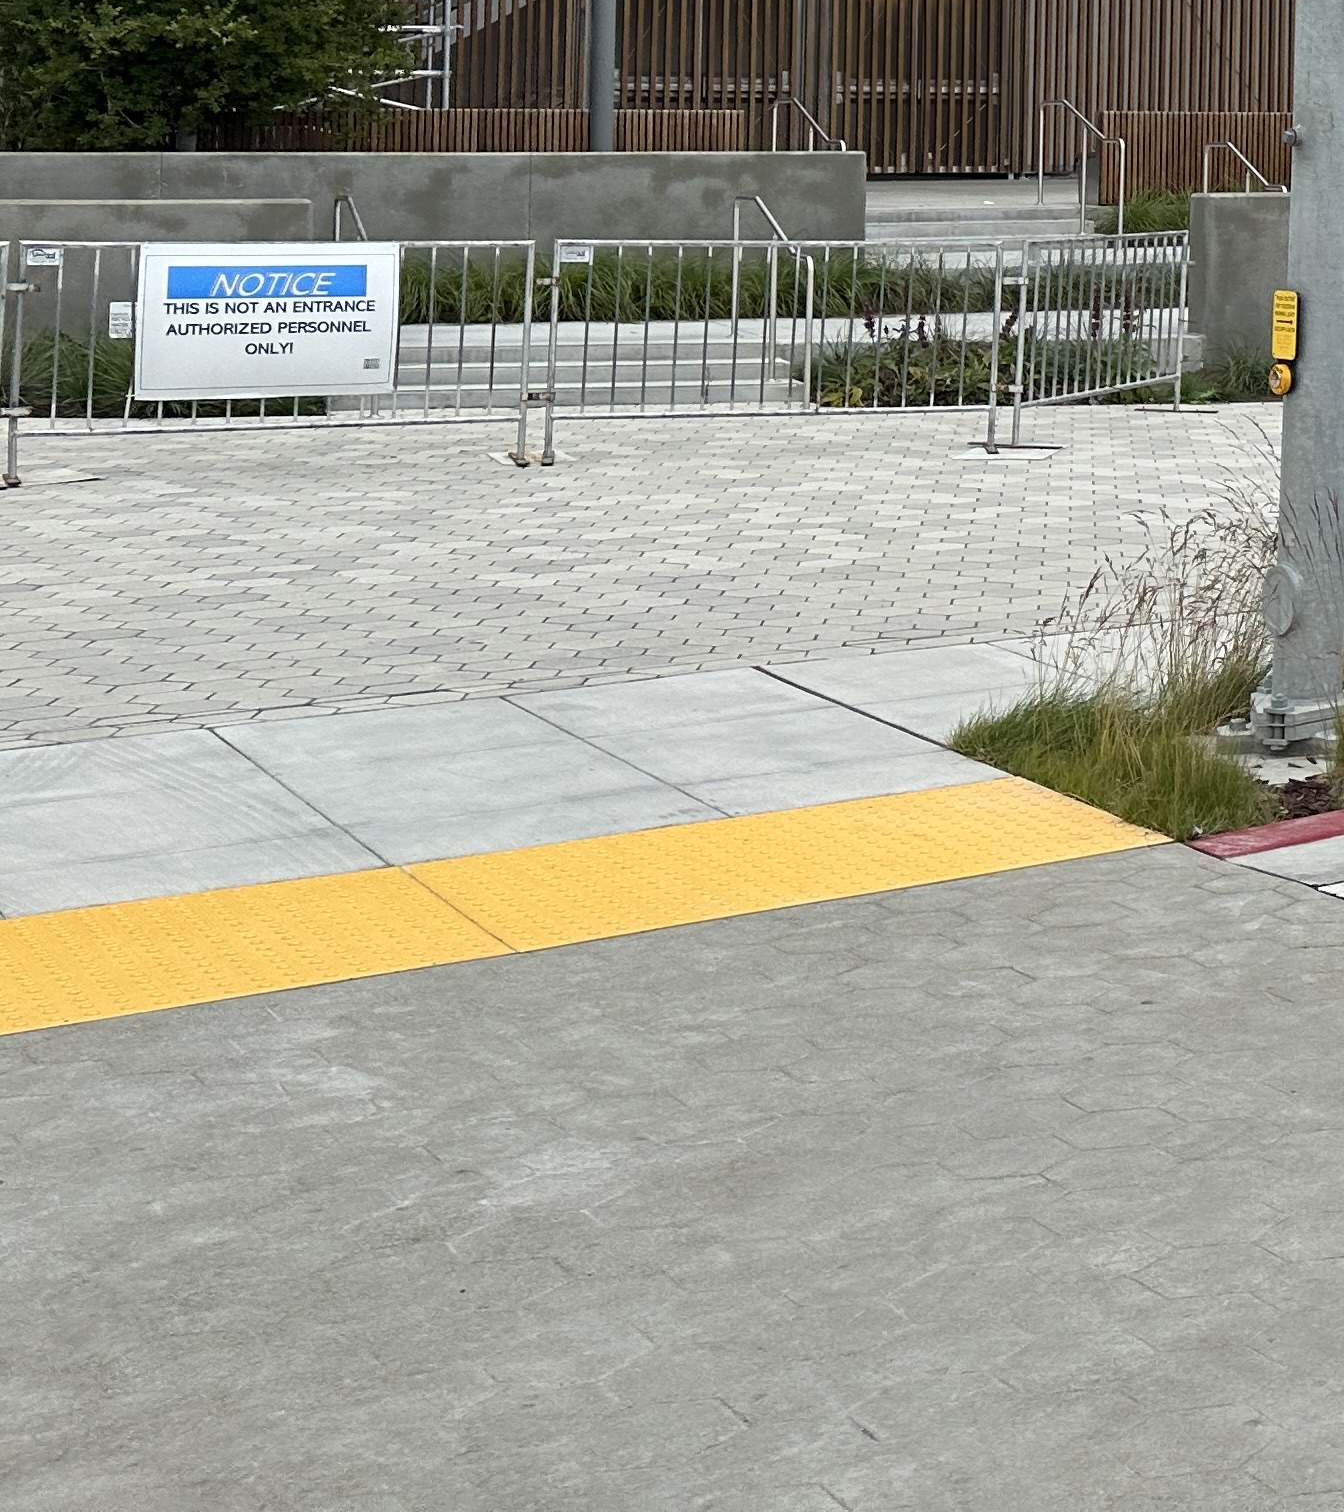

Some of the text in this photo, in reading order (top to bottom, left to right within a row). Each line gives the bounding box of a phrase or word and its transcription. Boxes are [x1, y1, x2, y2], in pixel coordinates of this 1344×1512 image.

[209, 272, 337, 297] NOTICE
[163, 299, 376, 315] THIS IS NOT AN ENTRANCE
[165, 320, 372, 336] AUTHORIZED PERSONNEL
